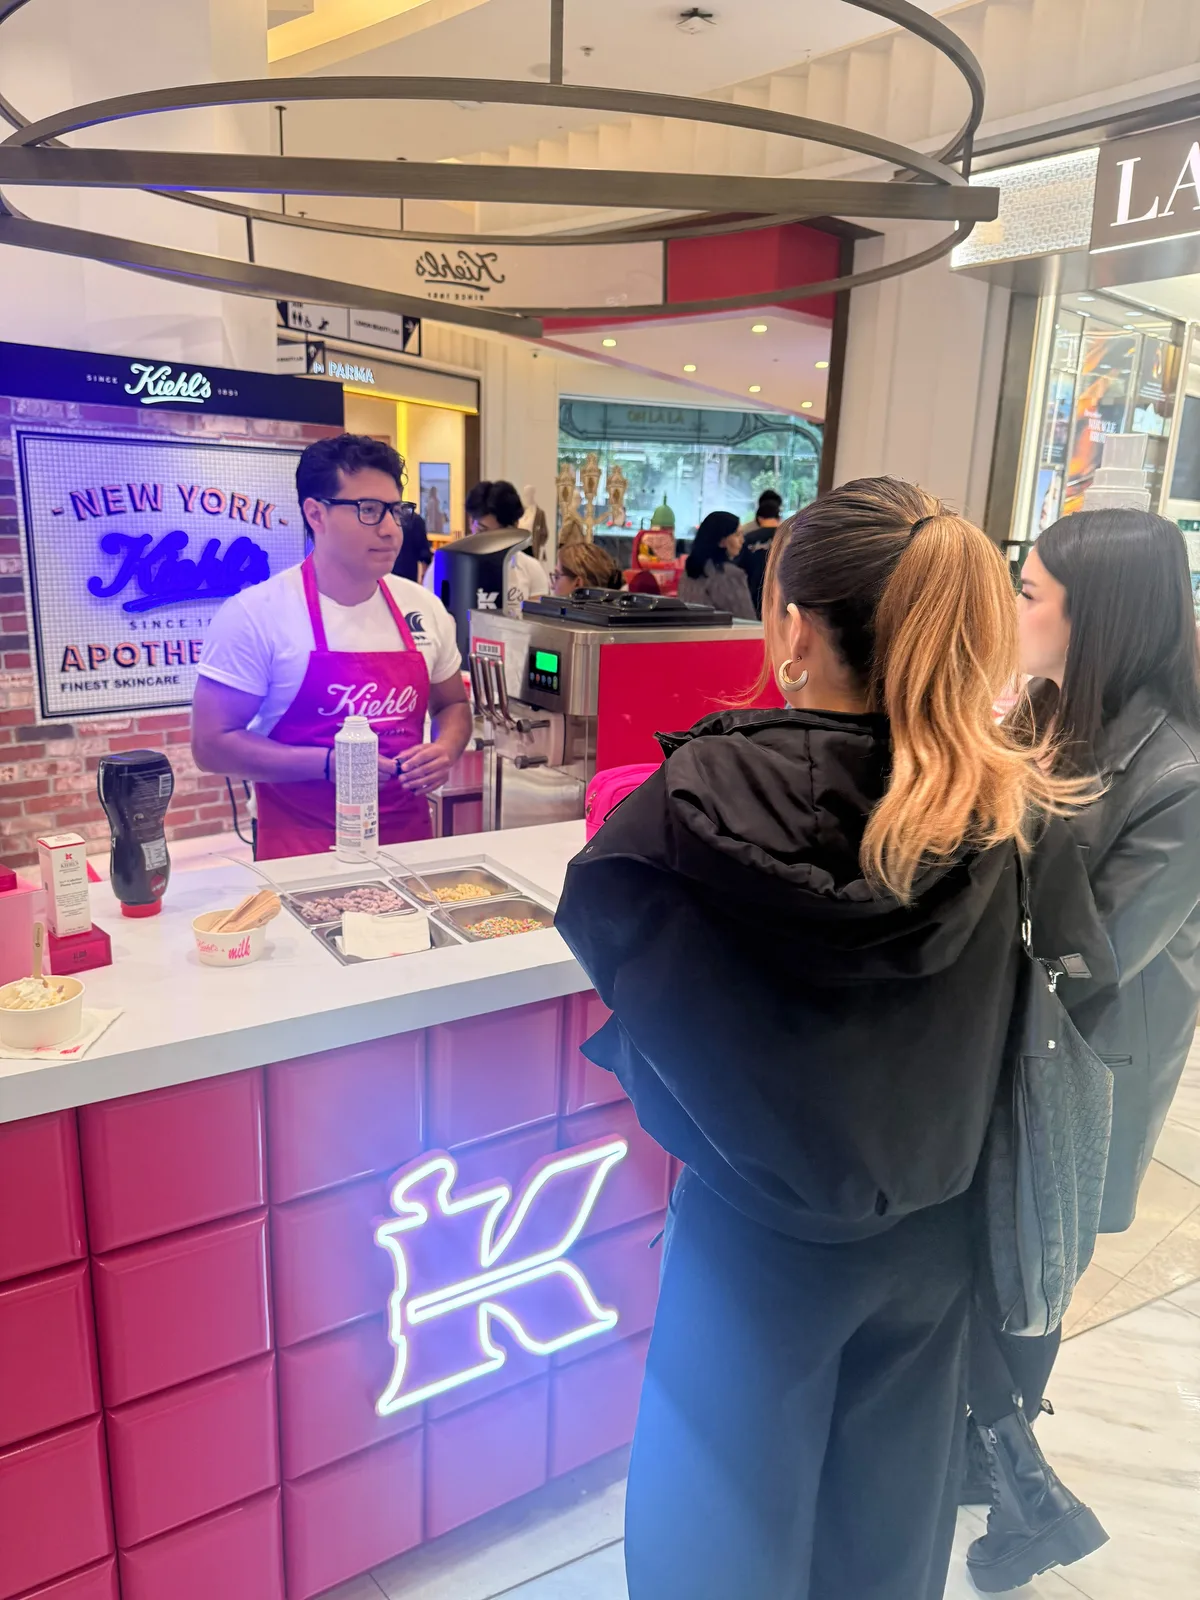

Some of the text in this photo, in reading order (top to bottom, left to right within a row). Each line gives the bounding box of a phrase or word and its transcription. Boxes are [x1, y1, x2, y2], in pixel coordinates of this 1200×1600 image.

[86, 374, 119, 385] SINCE
[124, 363, 212, 399] Kiehl's
[328, 361, 375, 384] PARMA
[69, 483, 276, 530] NEW YORK
[130, 619, 188, 631] SINCE
[61, 675, 181, 693] FINEST SKINCARE
[318, 682, 418, 716] Kiehl's
[228, 935, 251, 960] milk
